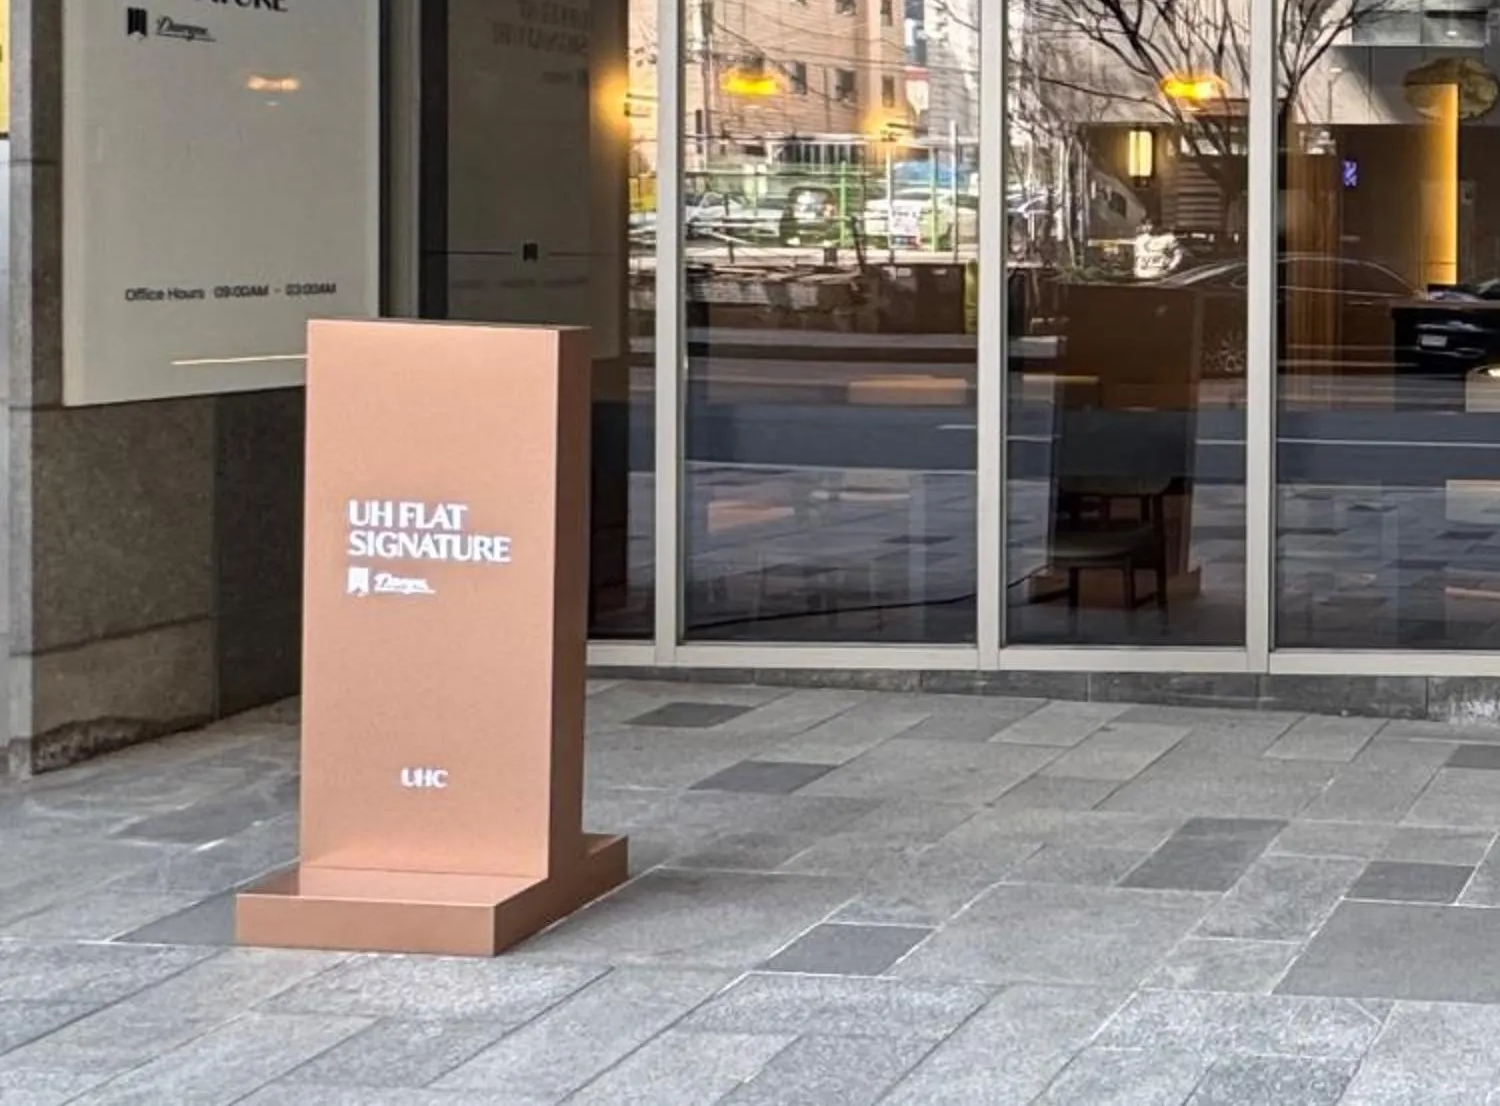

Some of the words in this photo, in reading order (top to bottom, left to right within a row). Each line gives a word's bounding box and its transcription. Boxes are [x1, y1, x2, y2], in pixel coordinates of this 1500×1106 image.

[124, 287, 164, 301] Office
[167, 287, 205, 300] Hours
[349, 500, 393, 526] UH
[400, 502, 468, 530] FLAT
[347, 530, 512, 562] SIGNATURE
